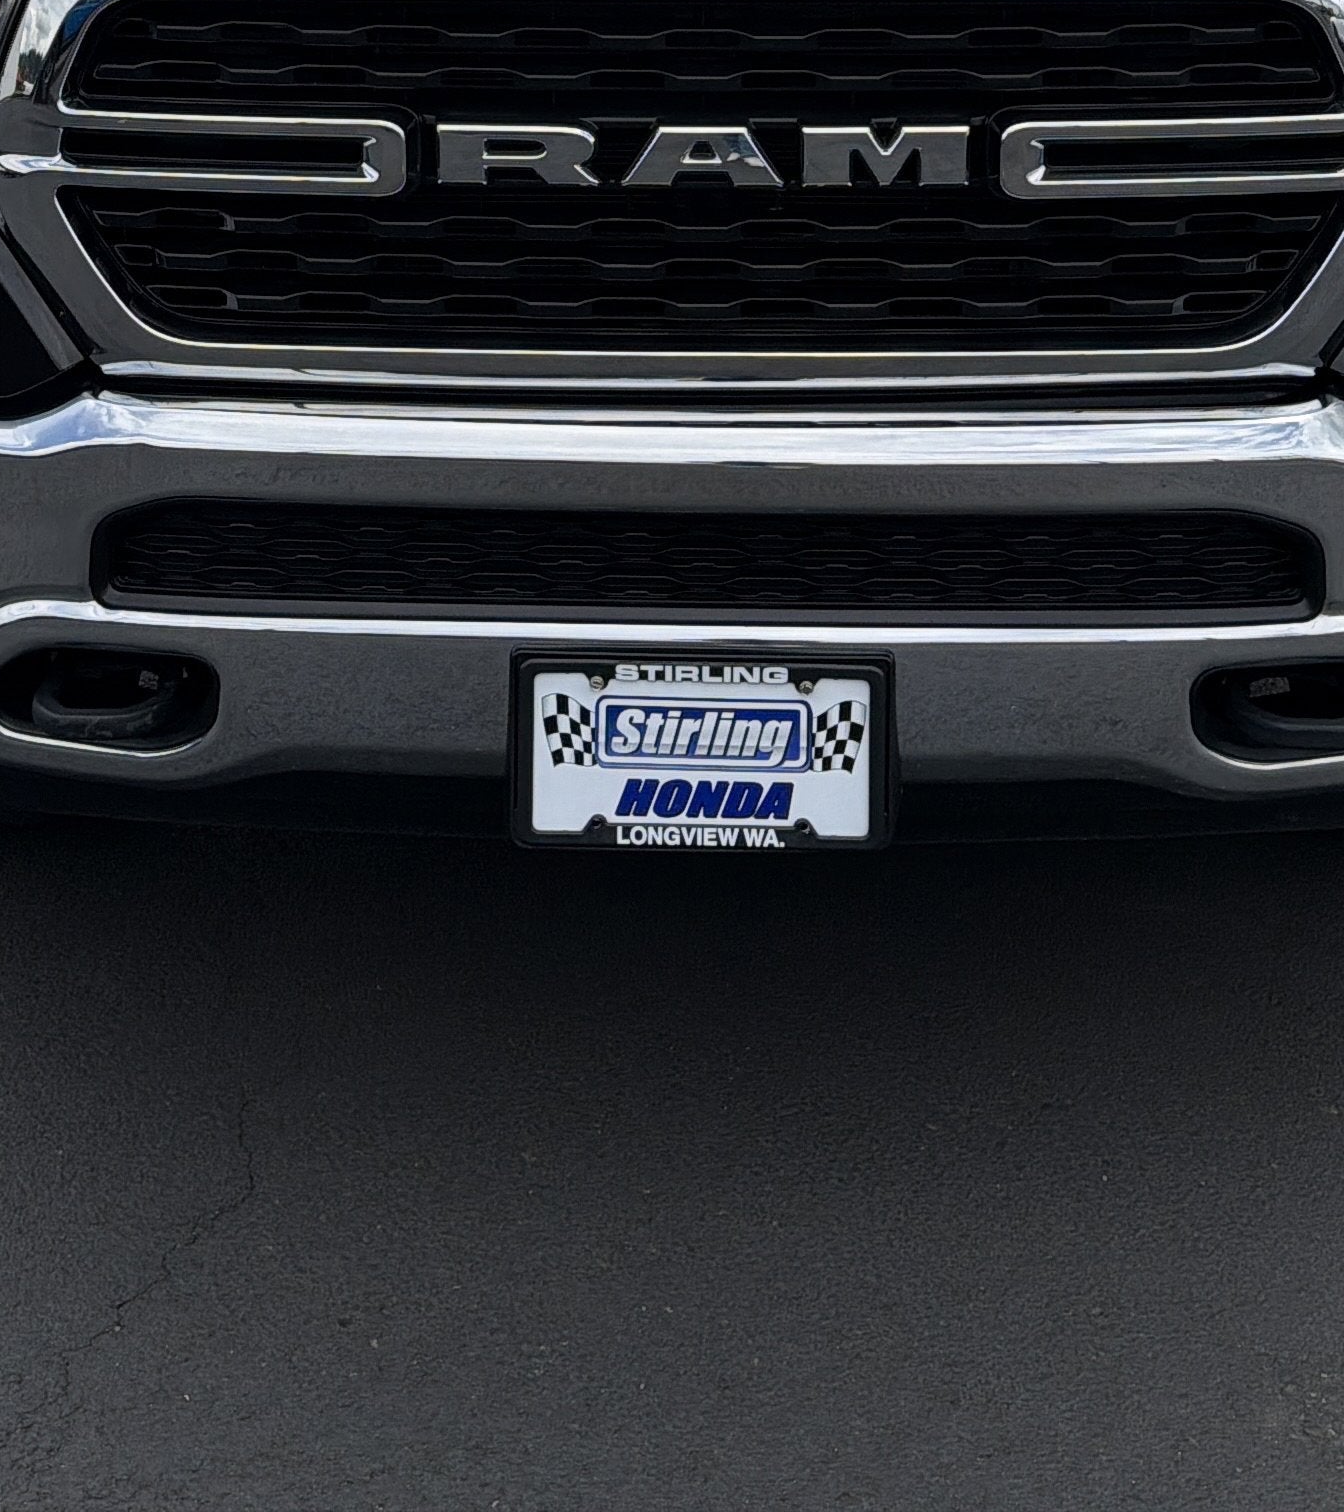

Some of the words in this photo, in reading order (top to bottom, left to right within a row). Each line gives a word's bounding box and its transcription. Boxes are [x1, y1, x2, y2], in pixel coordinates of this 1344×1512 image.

[436, 123, 971, 188] RAM
[614, 664, 790, 685] STIRLING
[610, 707, 794, 769] Stirling
[614, 777, 795, 820] HONDA
[615, 825, 740, 848] LONGVIEW
[742, 827, 787, 849] WA.
